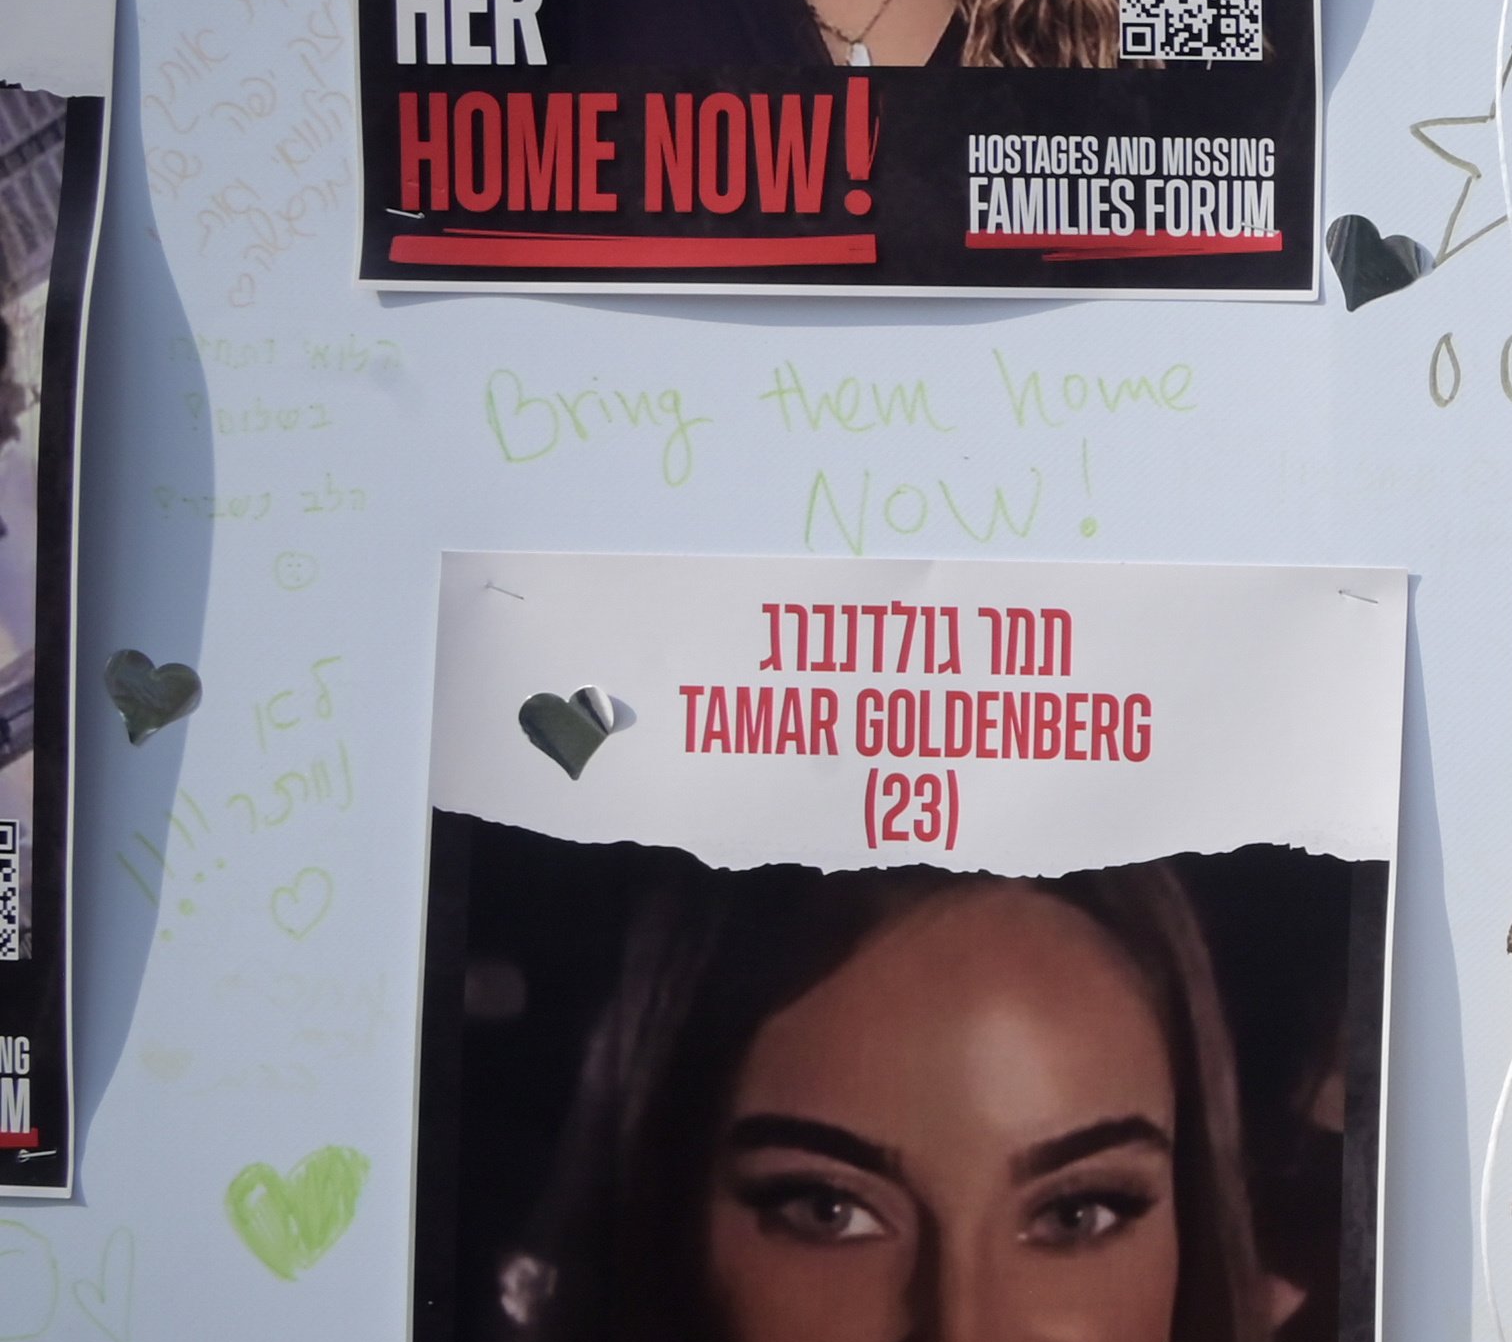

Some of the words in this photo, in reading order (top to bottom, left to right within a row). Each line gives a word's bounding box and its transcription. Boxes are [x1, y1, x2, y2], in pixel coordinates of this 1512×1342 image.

[969, 135, 1098, 175] HOSTAGES
[1104, 137, 1155, 175] AND
[1163, 138, 1274, 177] MISSING
[970, 177, 1134, 236] FAMILIES
[1146, 179, 1280, 237] FORUM
[484, 367, 713, 487] Bring
[760, 356, 951, 441] them
[992, 349, 1200, 427] home
[760, 601, 961, 674] גולדנברג
[979, 607, 1072, 676] תמר
[680, 685, 839, 755] TAMAR
[856, 688, 1152, 762] GOLDENBERG
[866, 768, 959, 851] (23)
